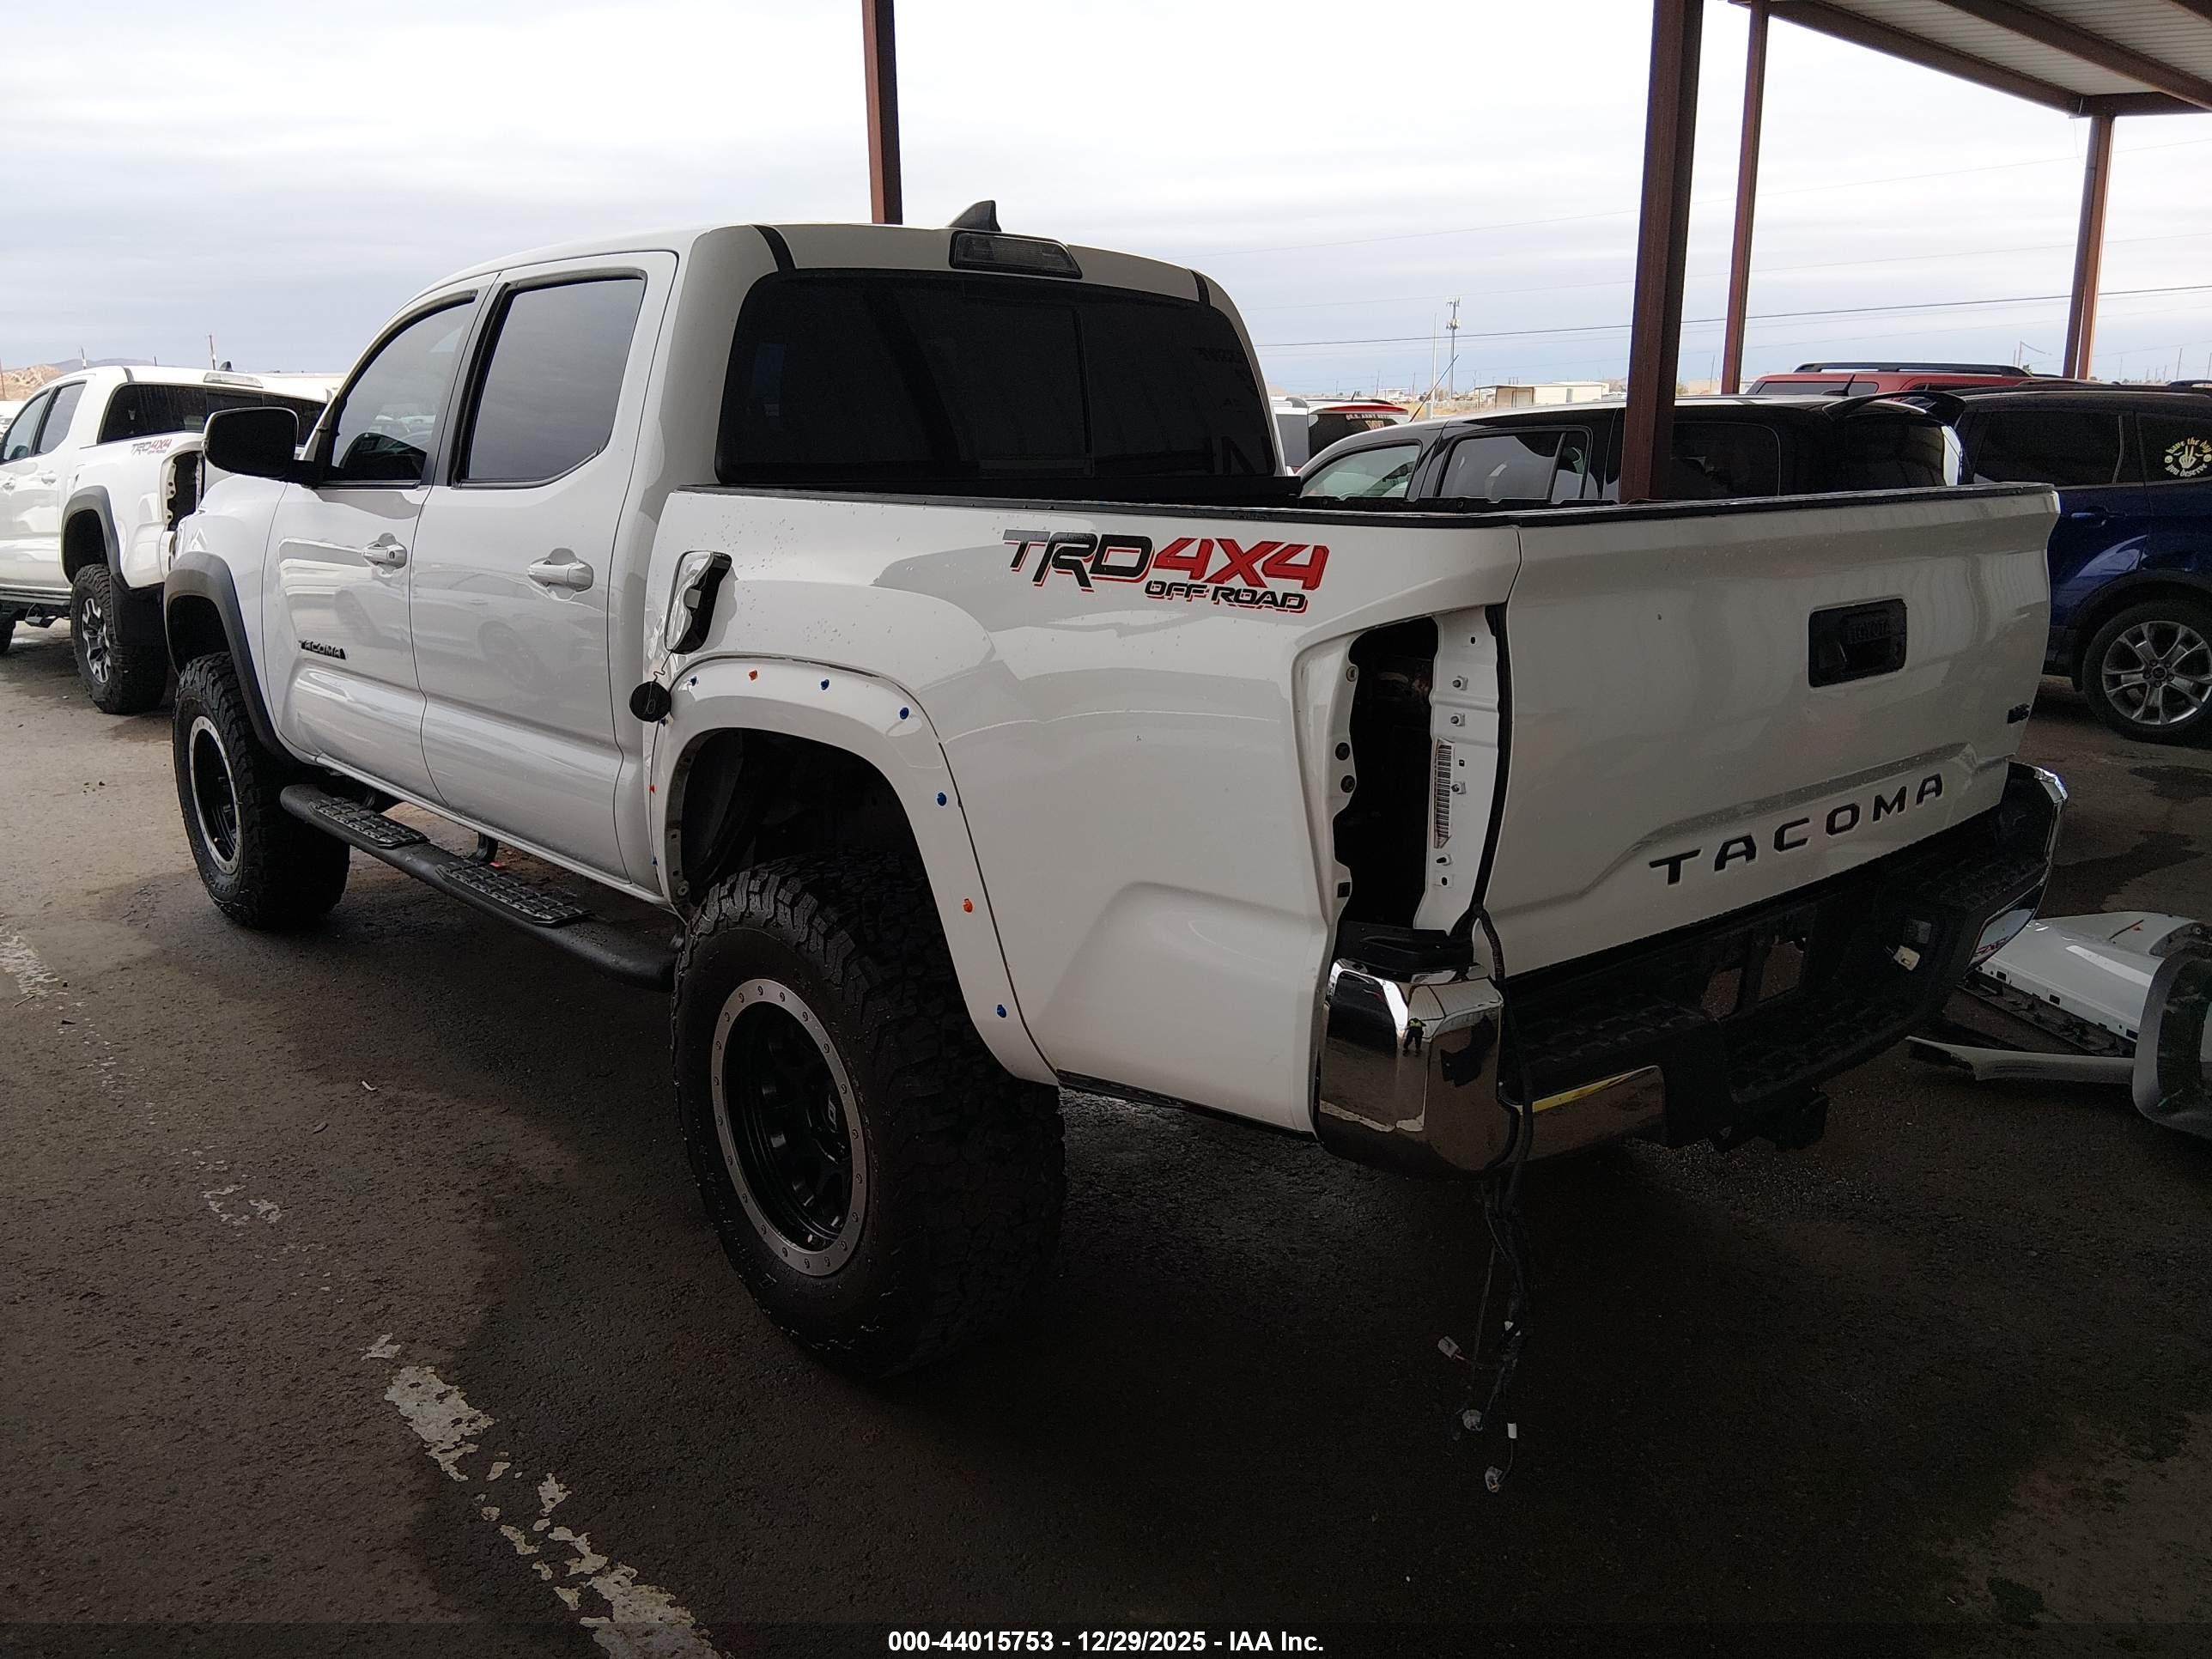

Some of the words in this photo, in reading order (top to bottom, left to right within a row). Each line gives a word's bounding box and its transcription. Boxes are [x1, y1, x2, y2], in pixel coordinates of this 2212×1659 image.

[2187, 437, 2200, 446] the
[1145, 580, 1206, 602] OFF
[1211, 588, 1310, 614] ROAD
[298, 640, 347, 660] TACOMA
[1648, 773, 1943, 886] TACOMA
